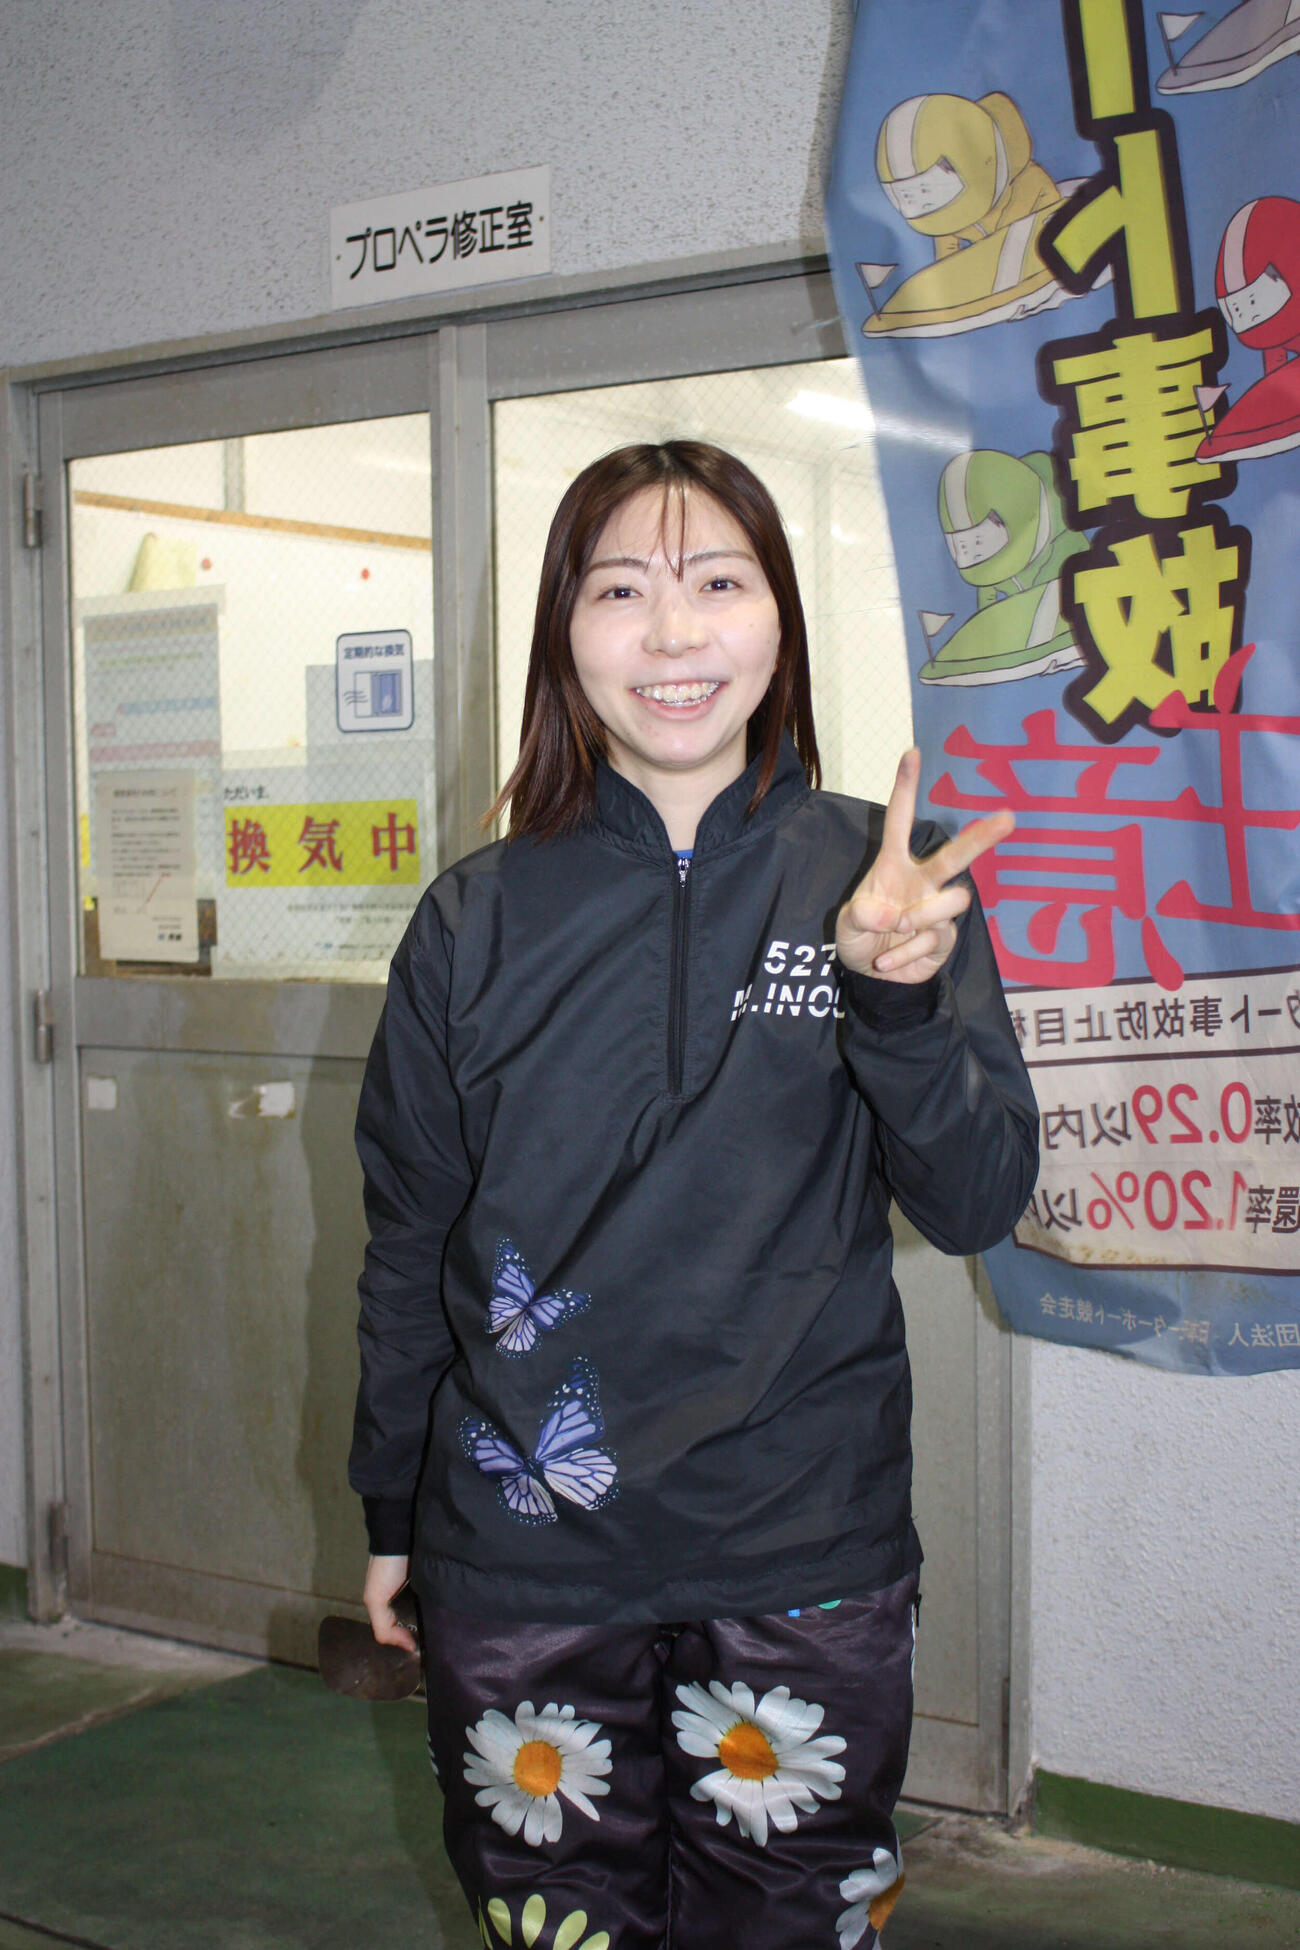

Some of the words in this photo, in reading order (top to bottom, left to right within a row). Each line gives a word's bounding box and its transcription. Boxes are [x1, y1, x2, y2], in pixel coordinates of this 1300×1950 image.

[346, 200, 534, 280] プロペラ修正室
[226, 811, 417, 876] 換気中
